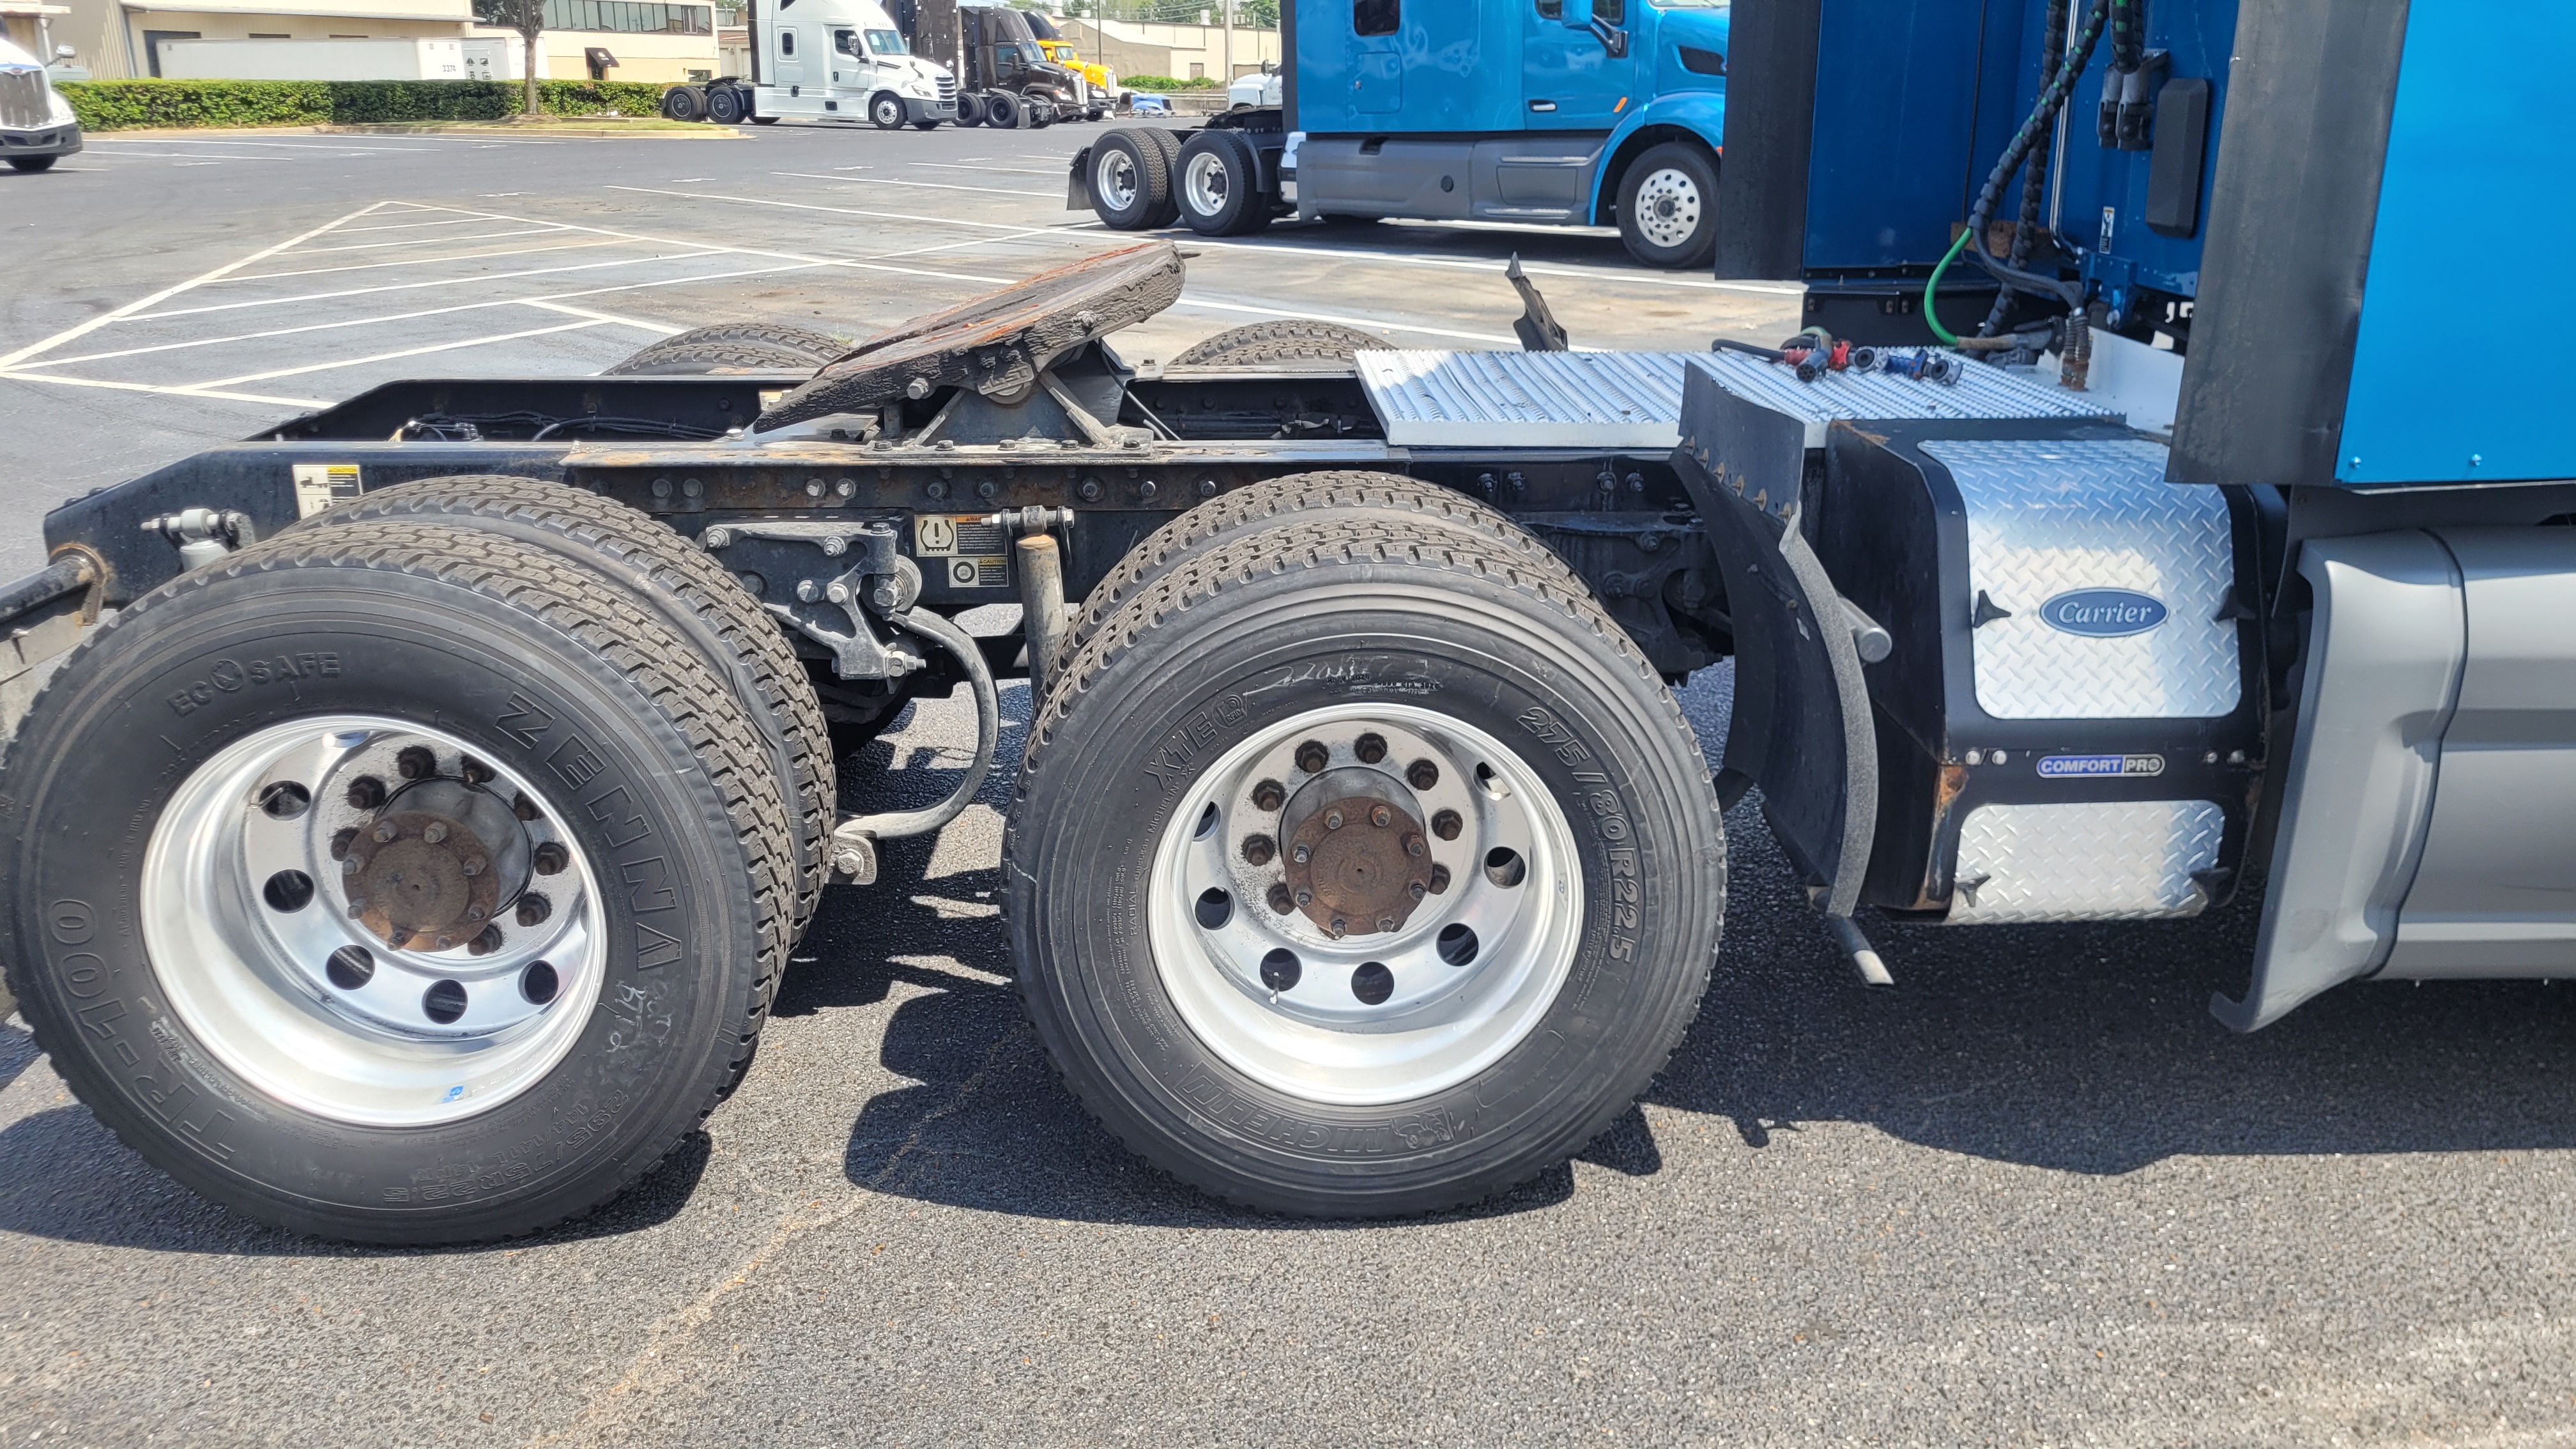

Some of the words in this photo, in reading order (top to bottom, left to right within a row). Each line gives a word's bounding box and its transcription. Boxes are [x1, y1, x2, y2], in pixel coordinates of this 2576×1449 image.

[2057, 601, 2152, 624] Carrier
[1144, 711, 1216, 790] XTE
[1226, 708, 1243, 722] RFID
[2040, 758, 2120, 774] COMFORT
[2125, 758, 2163, 773] PRO
[493, 691, 682, 969] ZENNA
[1126, 886, 1139, 936] RADIAL
[1146, 783, 1179, 834] MICHELIN
[1515, 700, 1642, 964] 275/80R22.5
[49, 898, 236, 1162] TR-100
[383, 1089, 627, 1204] 295/75R22.5
[492, 1103, 590, 1164] 144/141L
[1181, 1068, 1391, 1156] MICHELIN
[417, 1160, 482, 1181] 14PR
